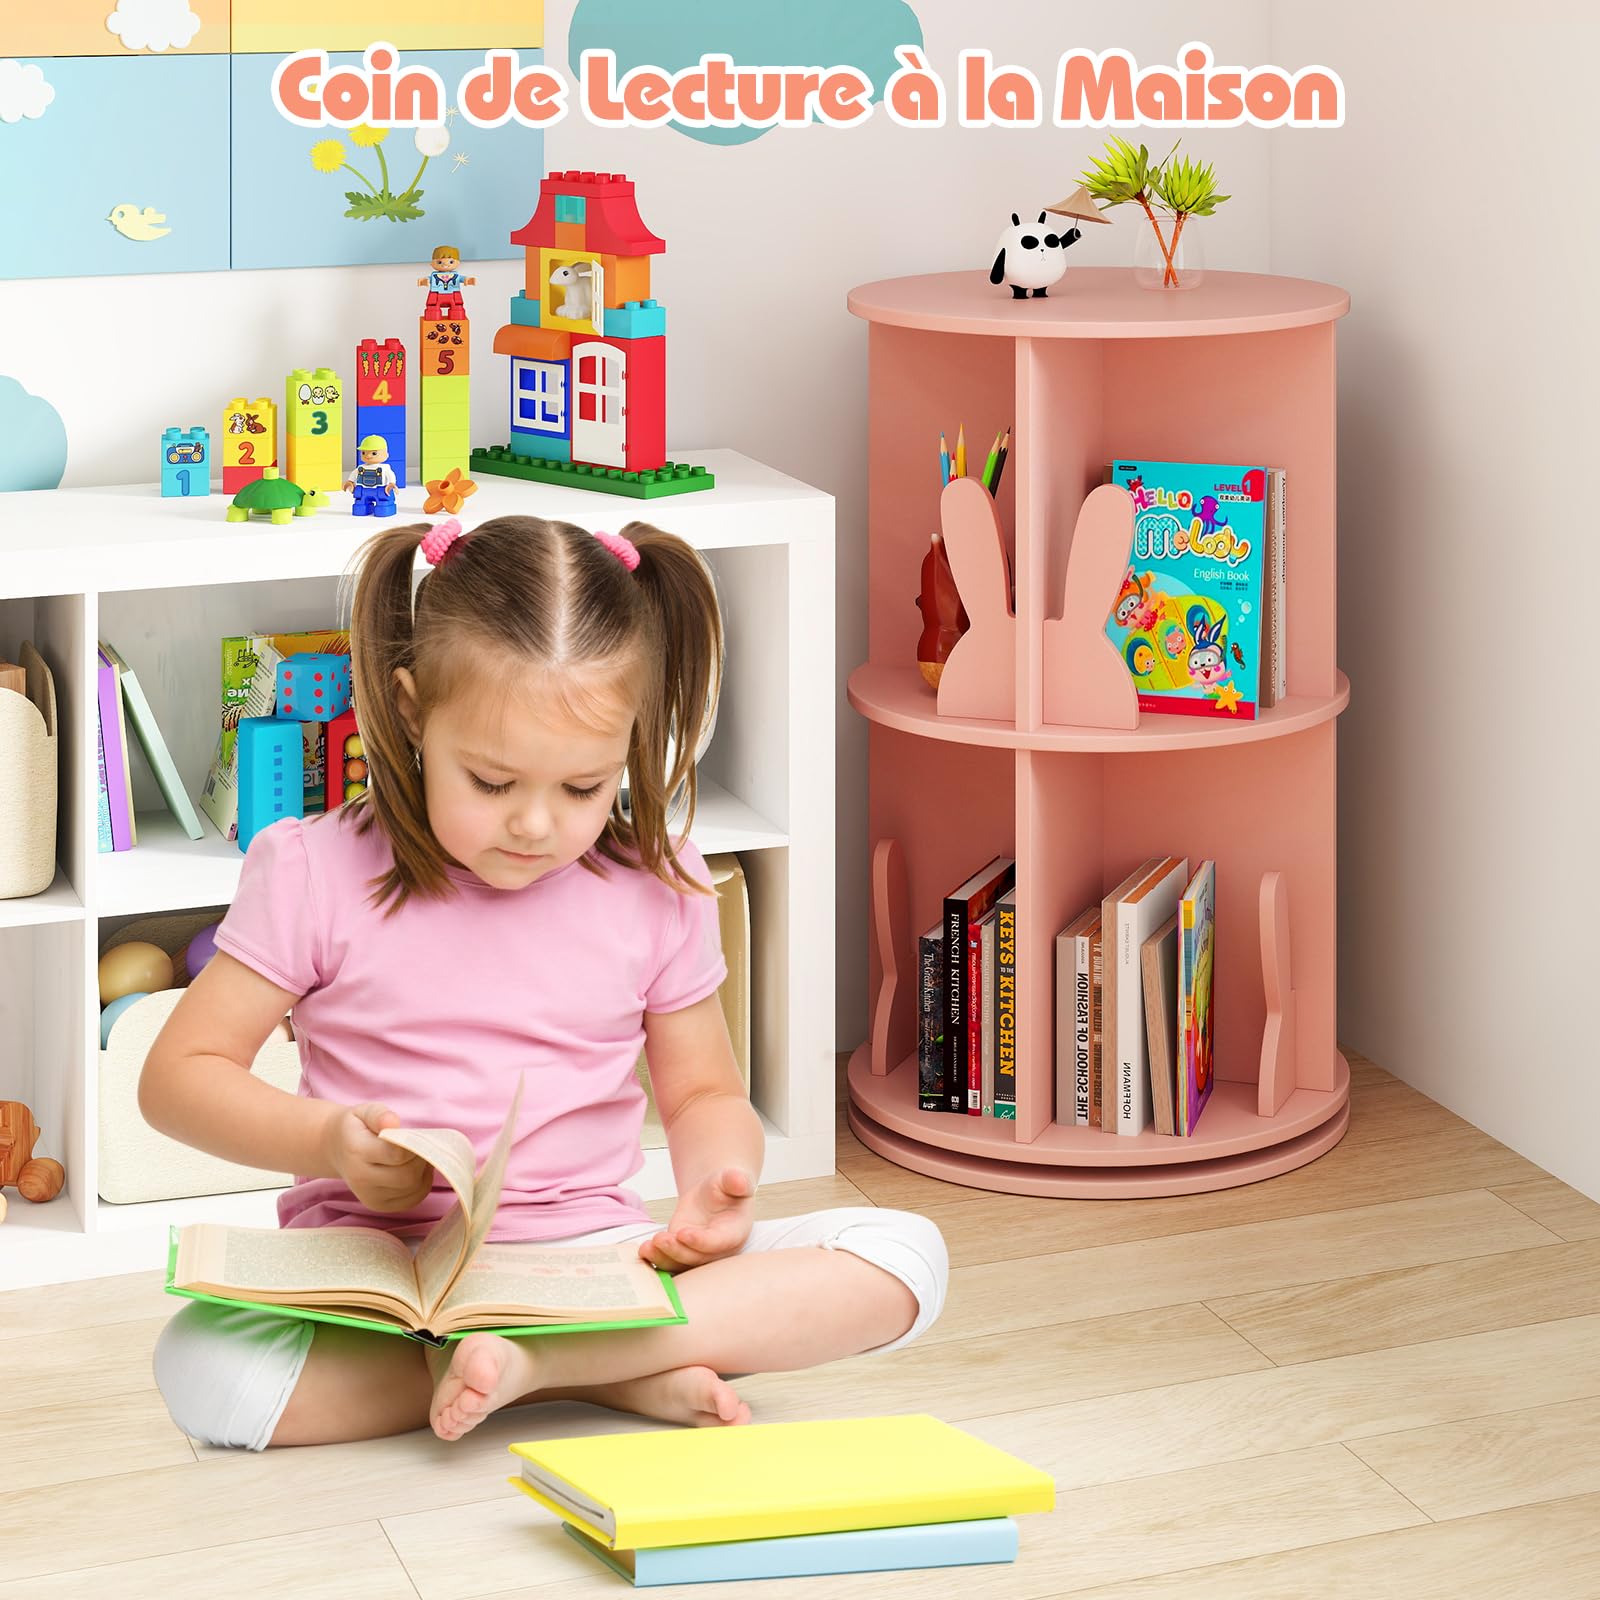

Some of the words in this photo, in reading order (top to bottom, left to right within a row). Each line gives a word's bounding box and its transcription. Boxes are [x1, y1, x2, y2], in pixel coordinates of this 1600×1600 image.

[437, 349, 455, 375] 5
[372, 379, 392, 404] 4
[311, 410, 329, 435] 3
[238, 441, 256, 465] 2
[175, 469, 190, 496] 1
[1213, 483, 1242, 492] LEVEL
[1243, 479, 1251, 493] 1
[1130, 487, 1192, 513] HELLO
[1193, 567, 1225, 582] English
[1227, 570, 1250, 582] Book
[951, 913, 960, 964] FRENCH
[999, 910, 1015, 965] KEYS
[923, 953, 935, 966] The
[923, 988, 936, 1012] Kitchen
[951, 968, 960, 1025] KITCHEN
[999, 975, 1015, 1077] KITCHEN
